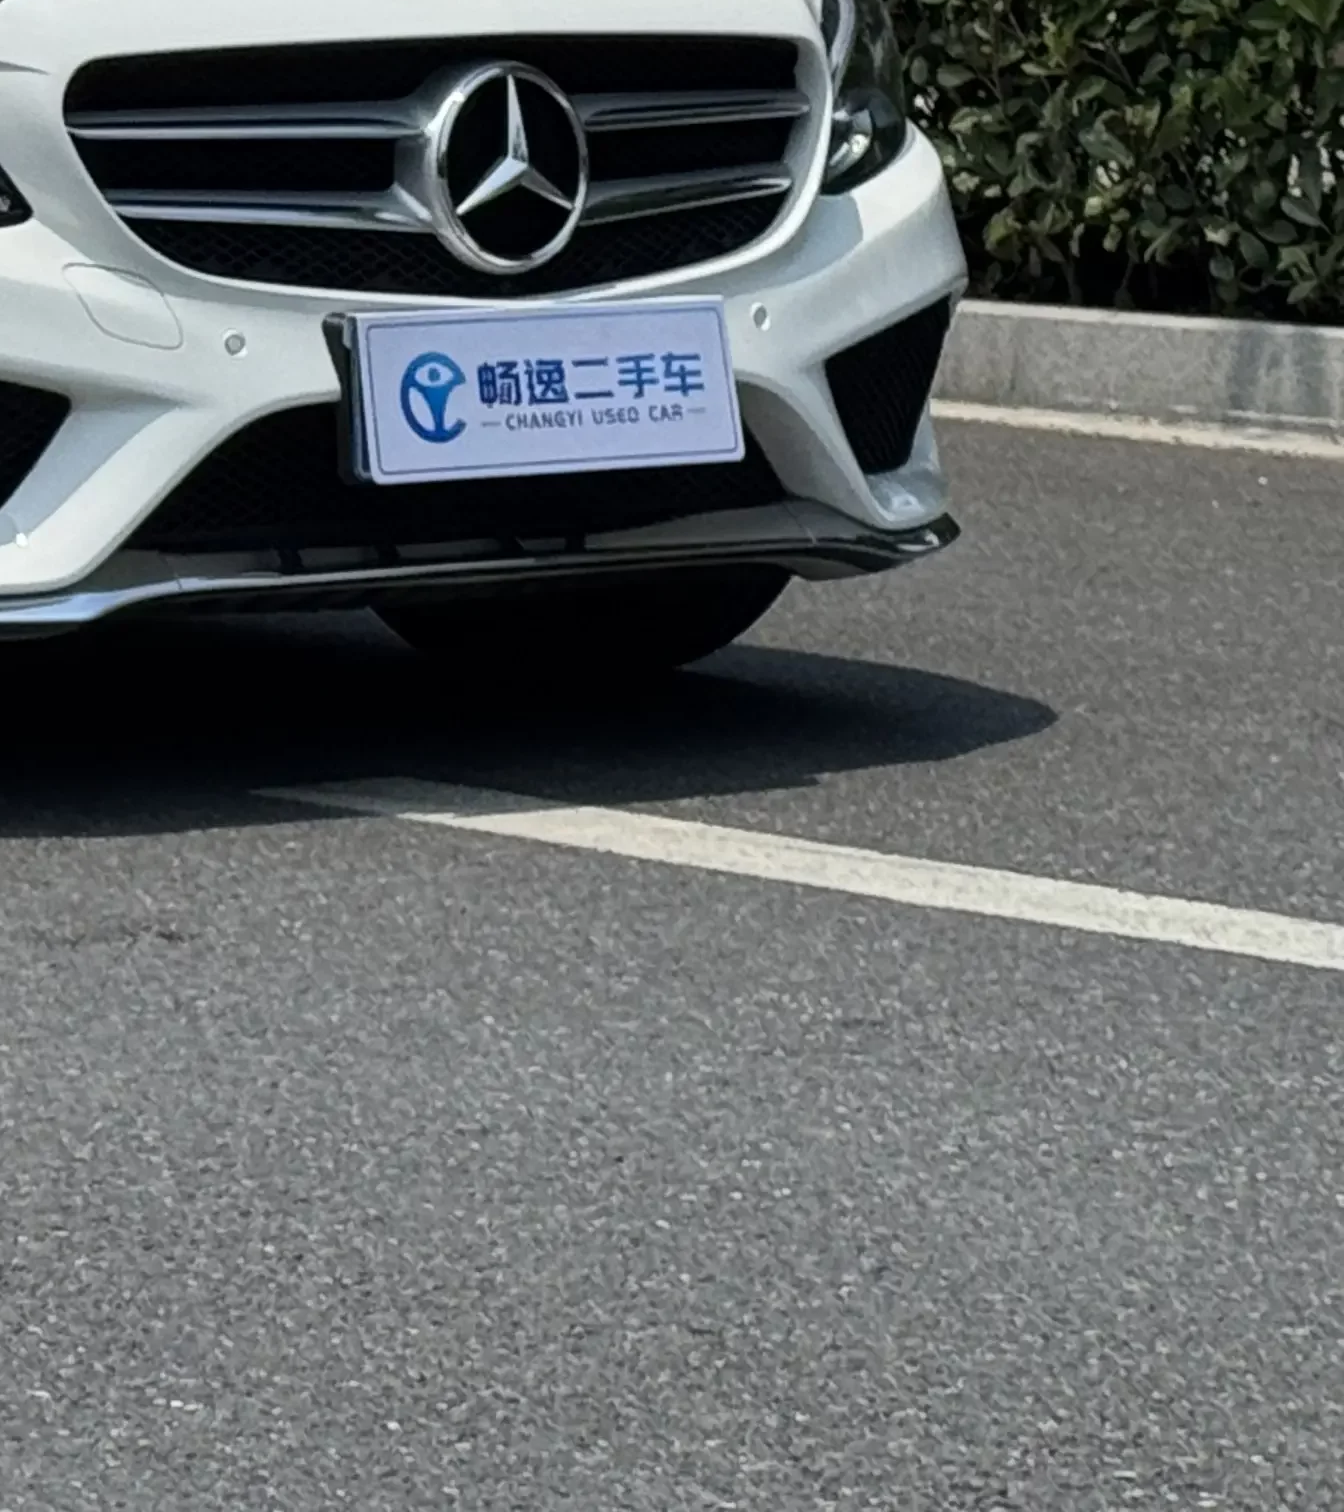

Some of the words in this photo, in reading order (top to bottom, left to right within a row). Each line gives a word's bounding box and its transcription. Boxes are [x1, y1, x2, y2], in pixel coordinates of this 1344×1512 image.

[477, 352, 705, 409] 畅逸二手车
[505, 410, 583, 431] CHANGYI
[591, 406, 640, 426] USED
[648, 403, 684, 423] CAR
